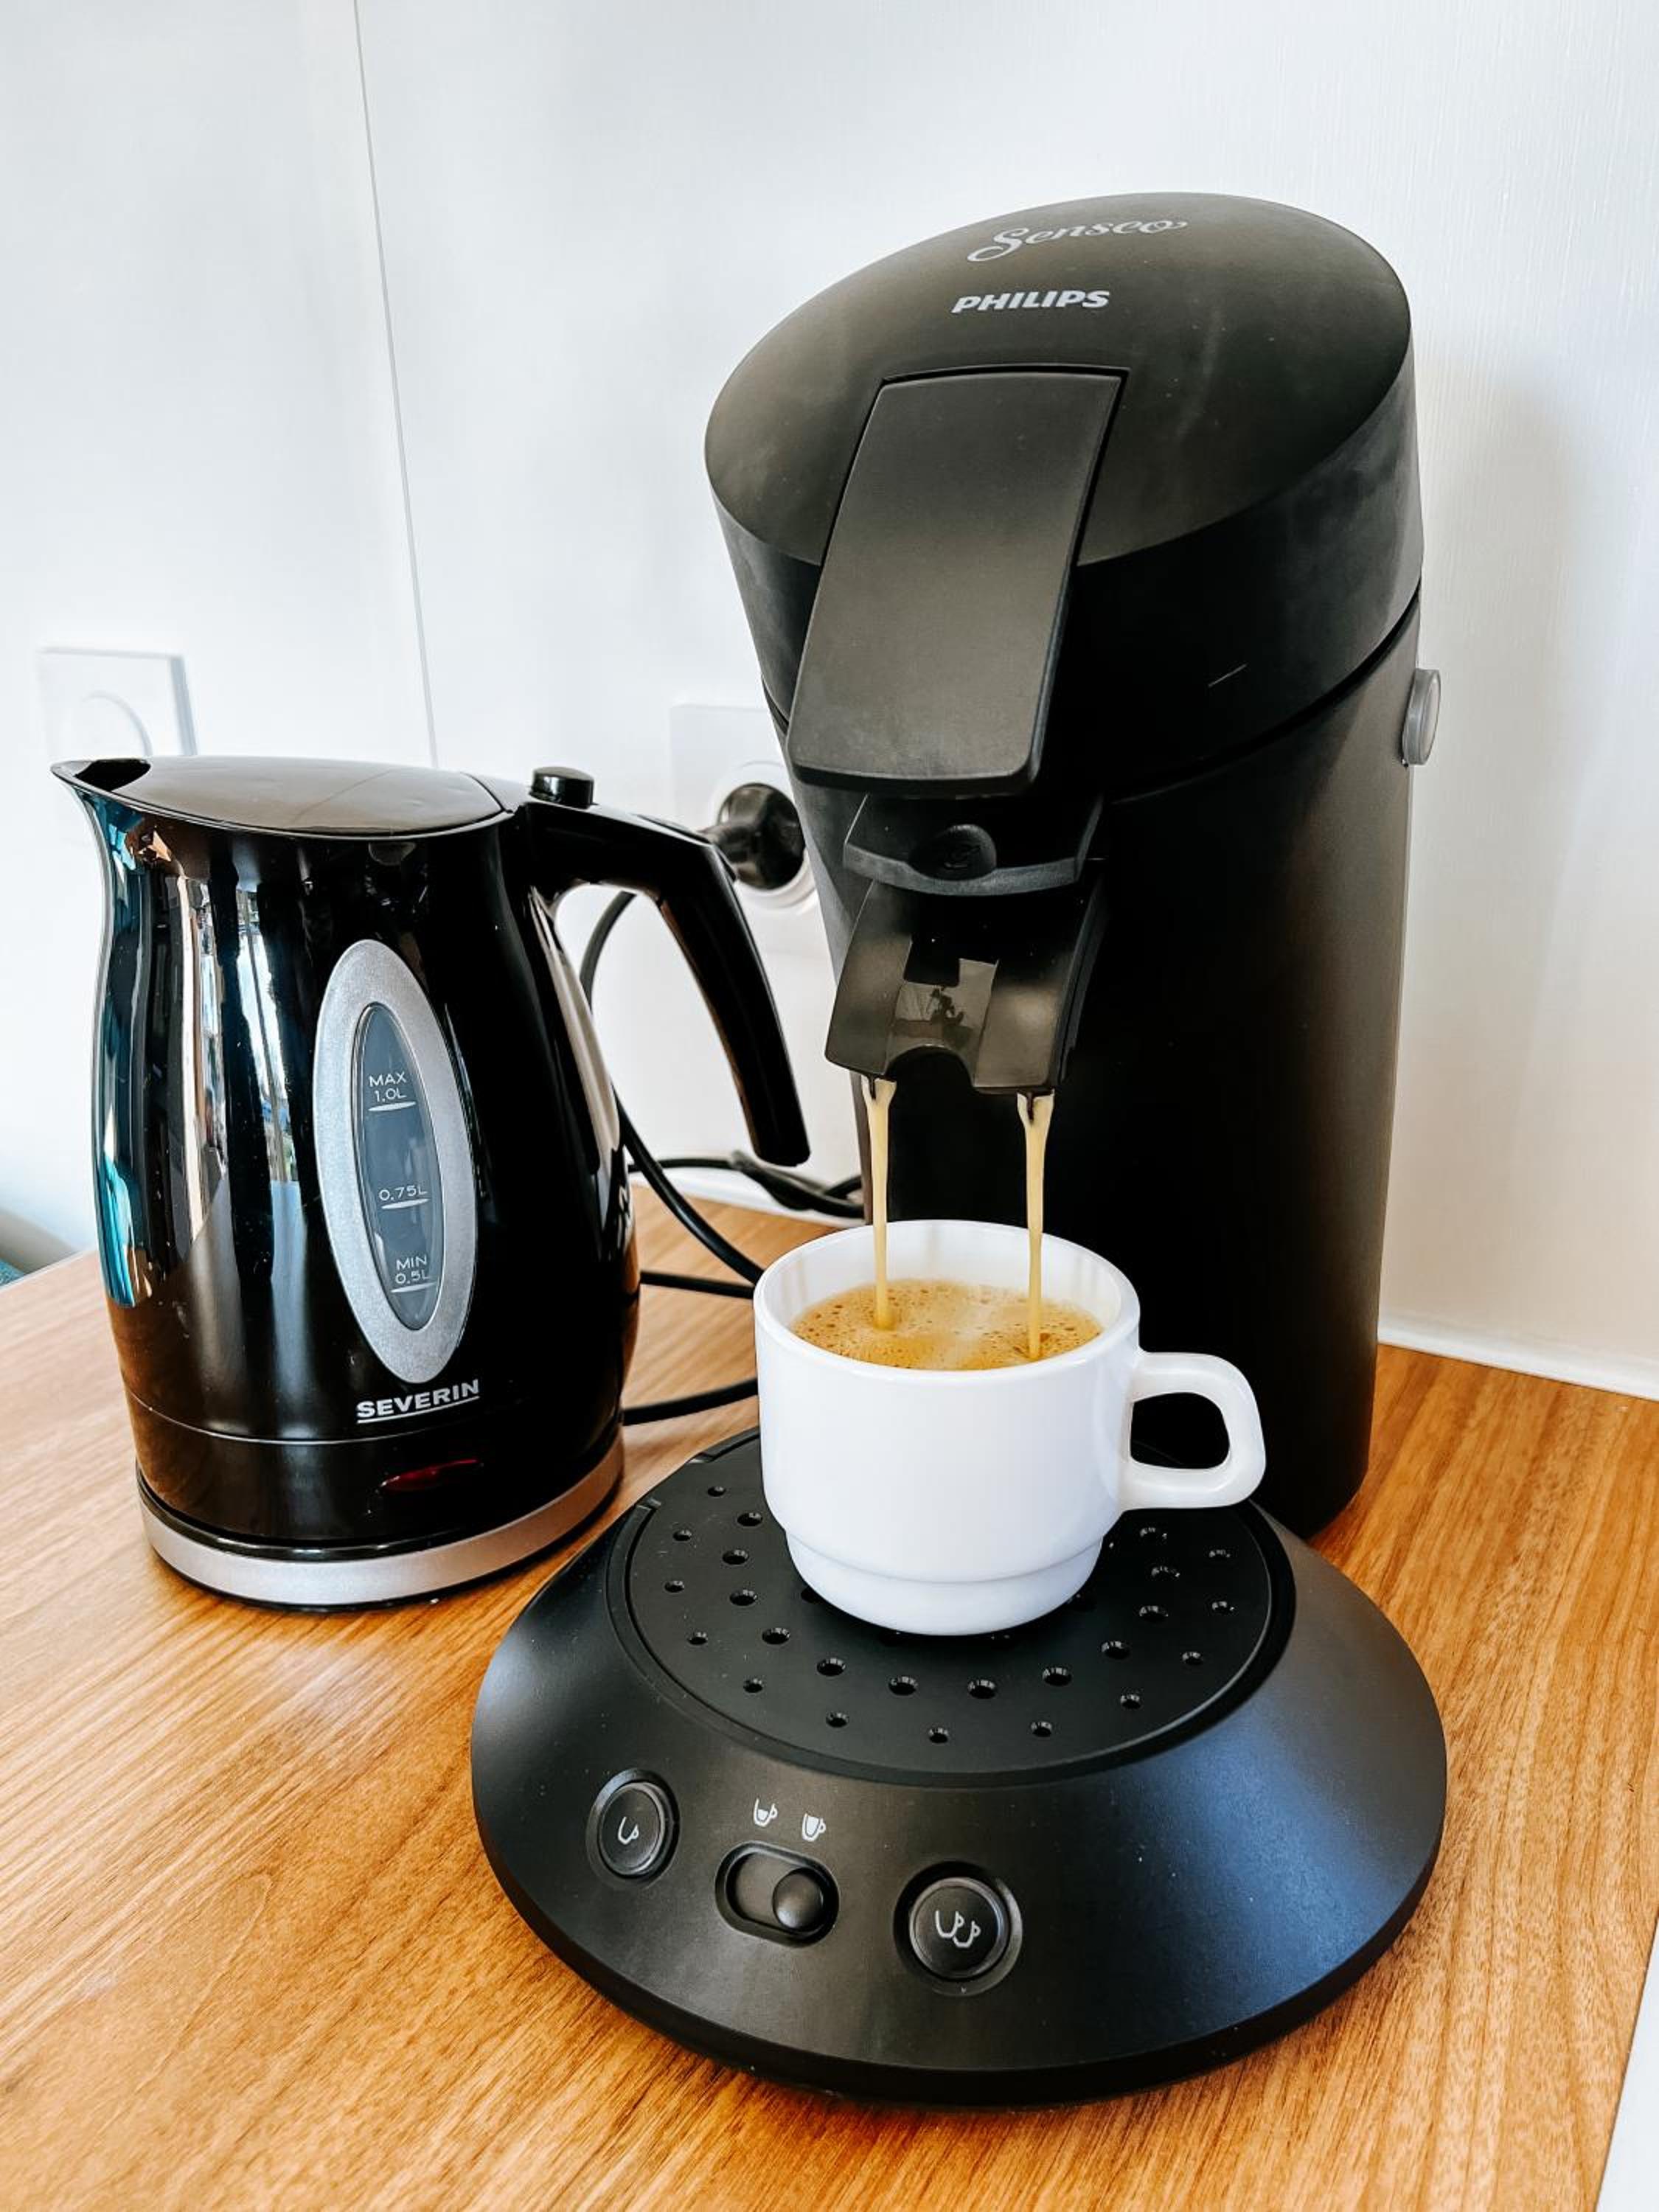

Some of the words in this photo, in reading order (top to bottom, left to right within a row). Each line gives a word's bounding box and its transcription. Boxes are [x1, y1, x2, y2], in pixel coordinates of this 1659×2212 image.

[967, 220, 1188, 262] Senseo
[951, 290, 1110, 313] PHILIPS
[369, 1071, 407, 1087] MAX
[375, 1088, 407, 1102] 1.0L
[379, 1185, 427, 1201] 0.75L
[396, 1255, 427, 1270] MIN
[394, 1267, 430, 1284] 0.5L
[356, 1379, 480, 1417] SEVERIN
